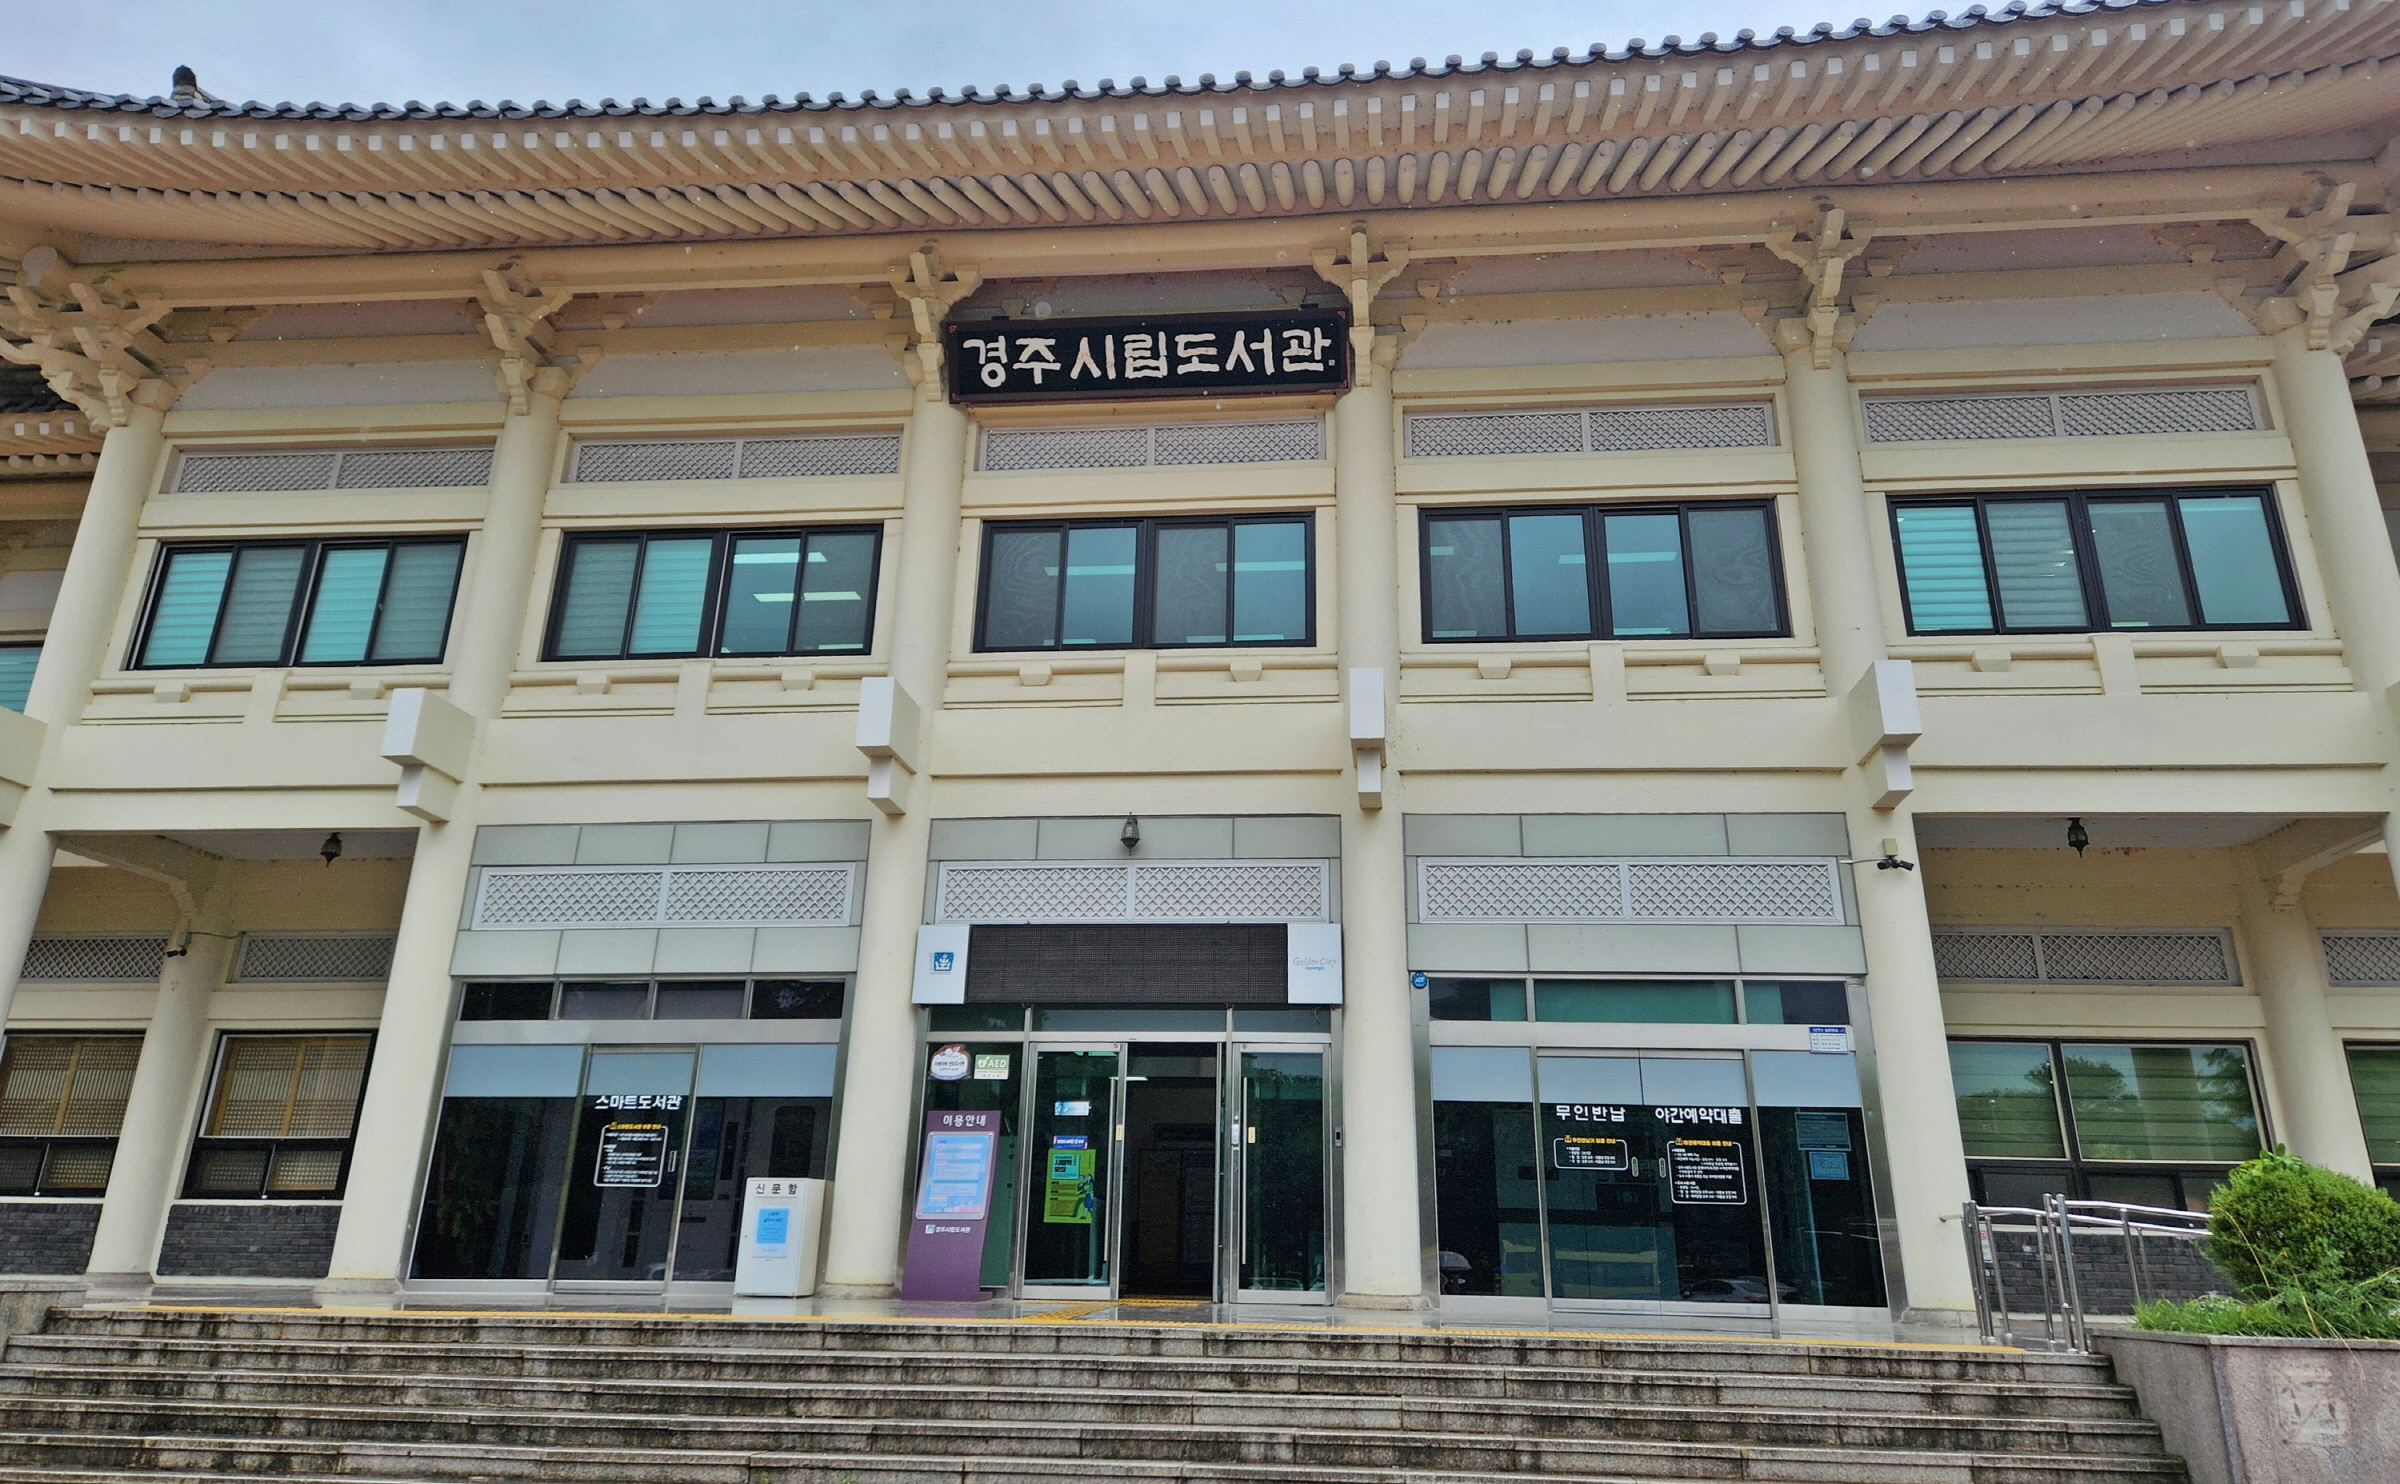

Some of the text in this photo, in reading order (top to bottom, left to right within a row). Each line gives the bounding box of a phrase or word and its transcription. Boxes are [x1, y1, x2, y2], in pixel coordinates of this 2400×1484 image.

[963, 327, 1332, 388] 경주시립도서관
[988, 1059, 1007, 1068] AED
[594, 1095, 682, 1110] 스마트도서관
[943, 1114, 986, 1128] 이용안내
[1556, 1105, 1626, 1122] 무인반납
[1655, 1107, 1743, 1125] 야간예약대출
[935, 1226, 971, 1234] 경주시립도서관
